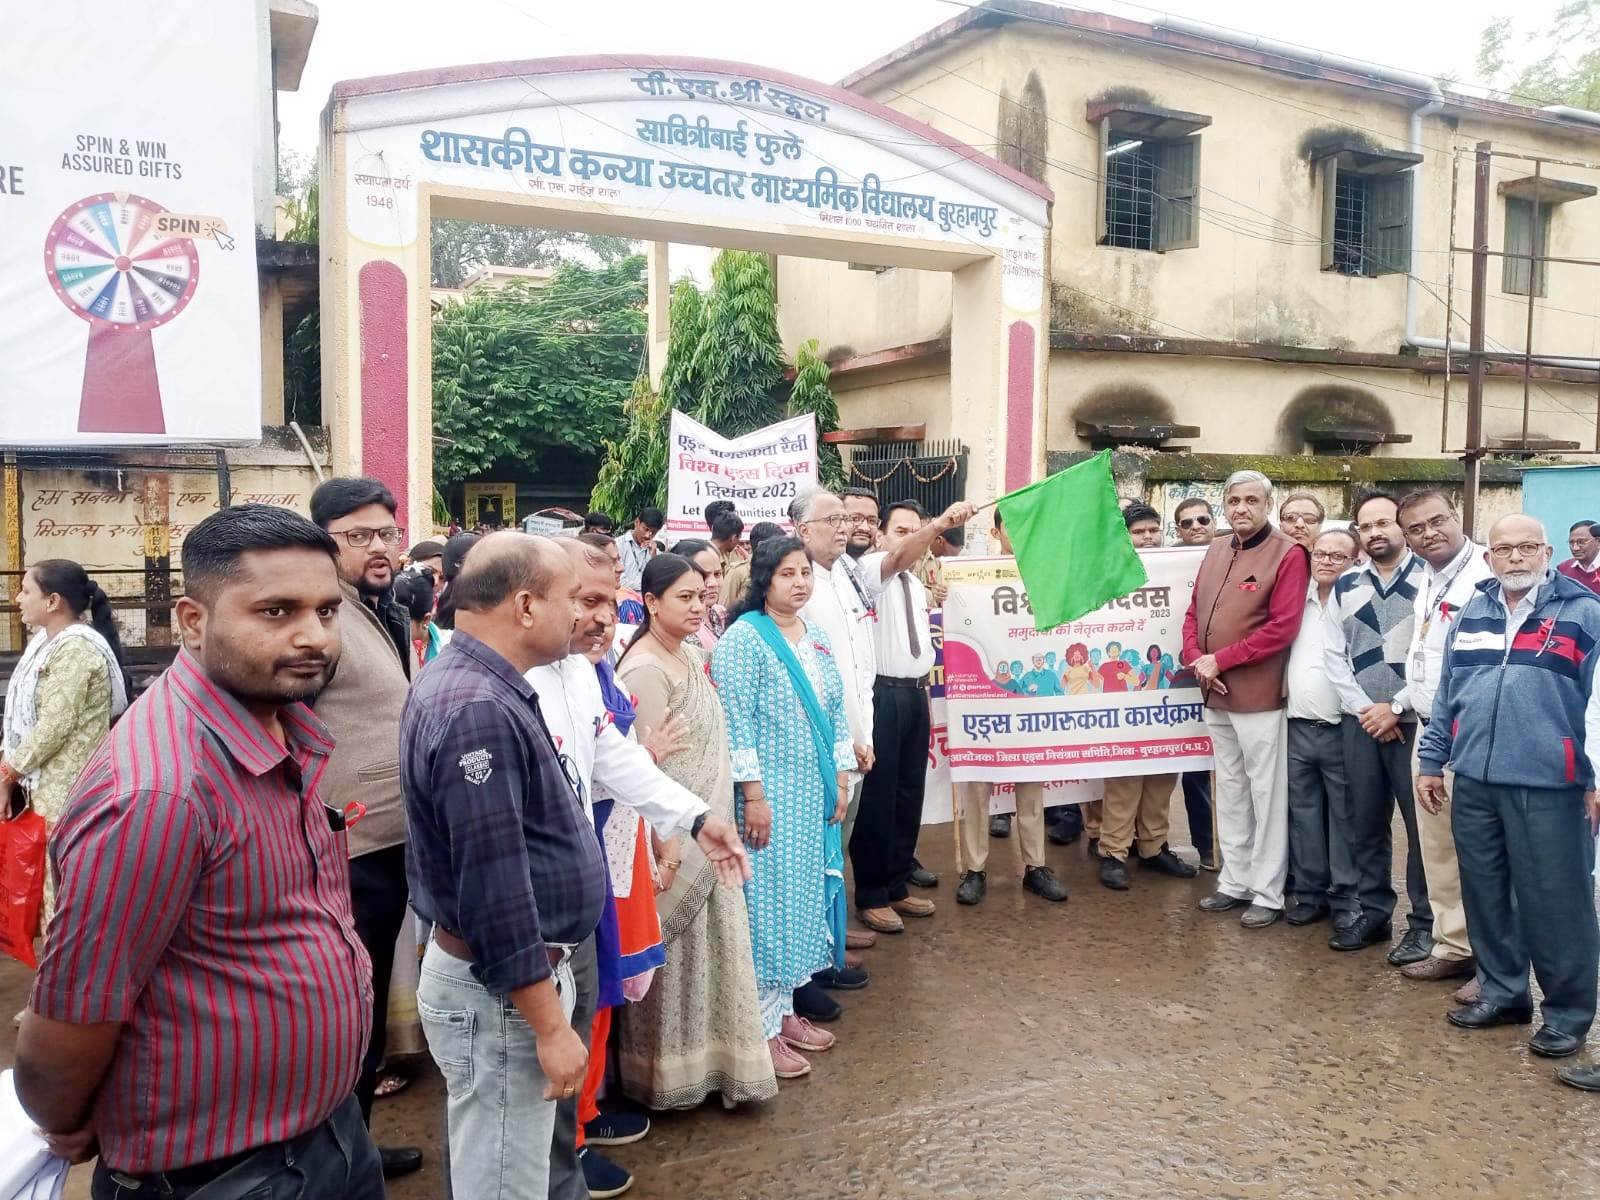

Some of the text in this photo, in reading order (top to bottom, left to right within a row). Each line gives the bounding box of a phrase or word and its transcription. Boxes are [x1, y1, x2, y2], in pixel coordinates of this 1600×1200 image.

[76, 134, 166, 159] SPIN & WIN
[636, 113, 804, 165] सावित्रीबाई फुले
[62, 152, 182, 179] ASSURED GIFTS
[420, 126, 999, 238] शासकीय कन्या उच्चतर माध्यमिक विद्यालय बुरहानपुर
[367, 194, 393, 210] 1948
[158, 217, 200, 233] SPIN
[779, 433, 809, 454] रैली
[678, 452, 720, 474] विश्व
[763, 460, 810, 479] दिवस
[176, 492, 213, 507] एक
[694, 480, 797, 499] 1 दिसंबर 2023
[32, 490, 69, 511] हम
[682, 505, 699, 516] Let
[33, 518, 105, 538] मिजल्स
[1150, 609, 1171, 618] 2023
[1073, 620, 1105, 638] नेतृत्व
[1107, 618, 1136, 633] करने
[1136, 618, 1147, 632] दें
[962, 695, 1205, 743] एड्स जागरूकता कार्यक्रम
[996, 751, 1020, 762] जिला
[1022, 753, 1044, 764] एड्स
[1046, 749, 1080, 761] नियंत्रण
